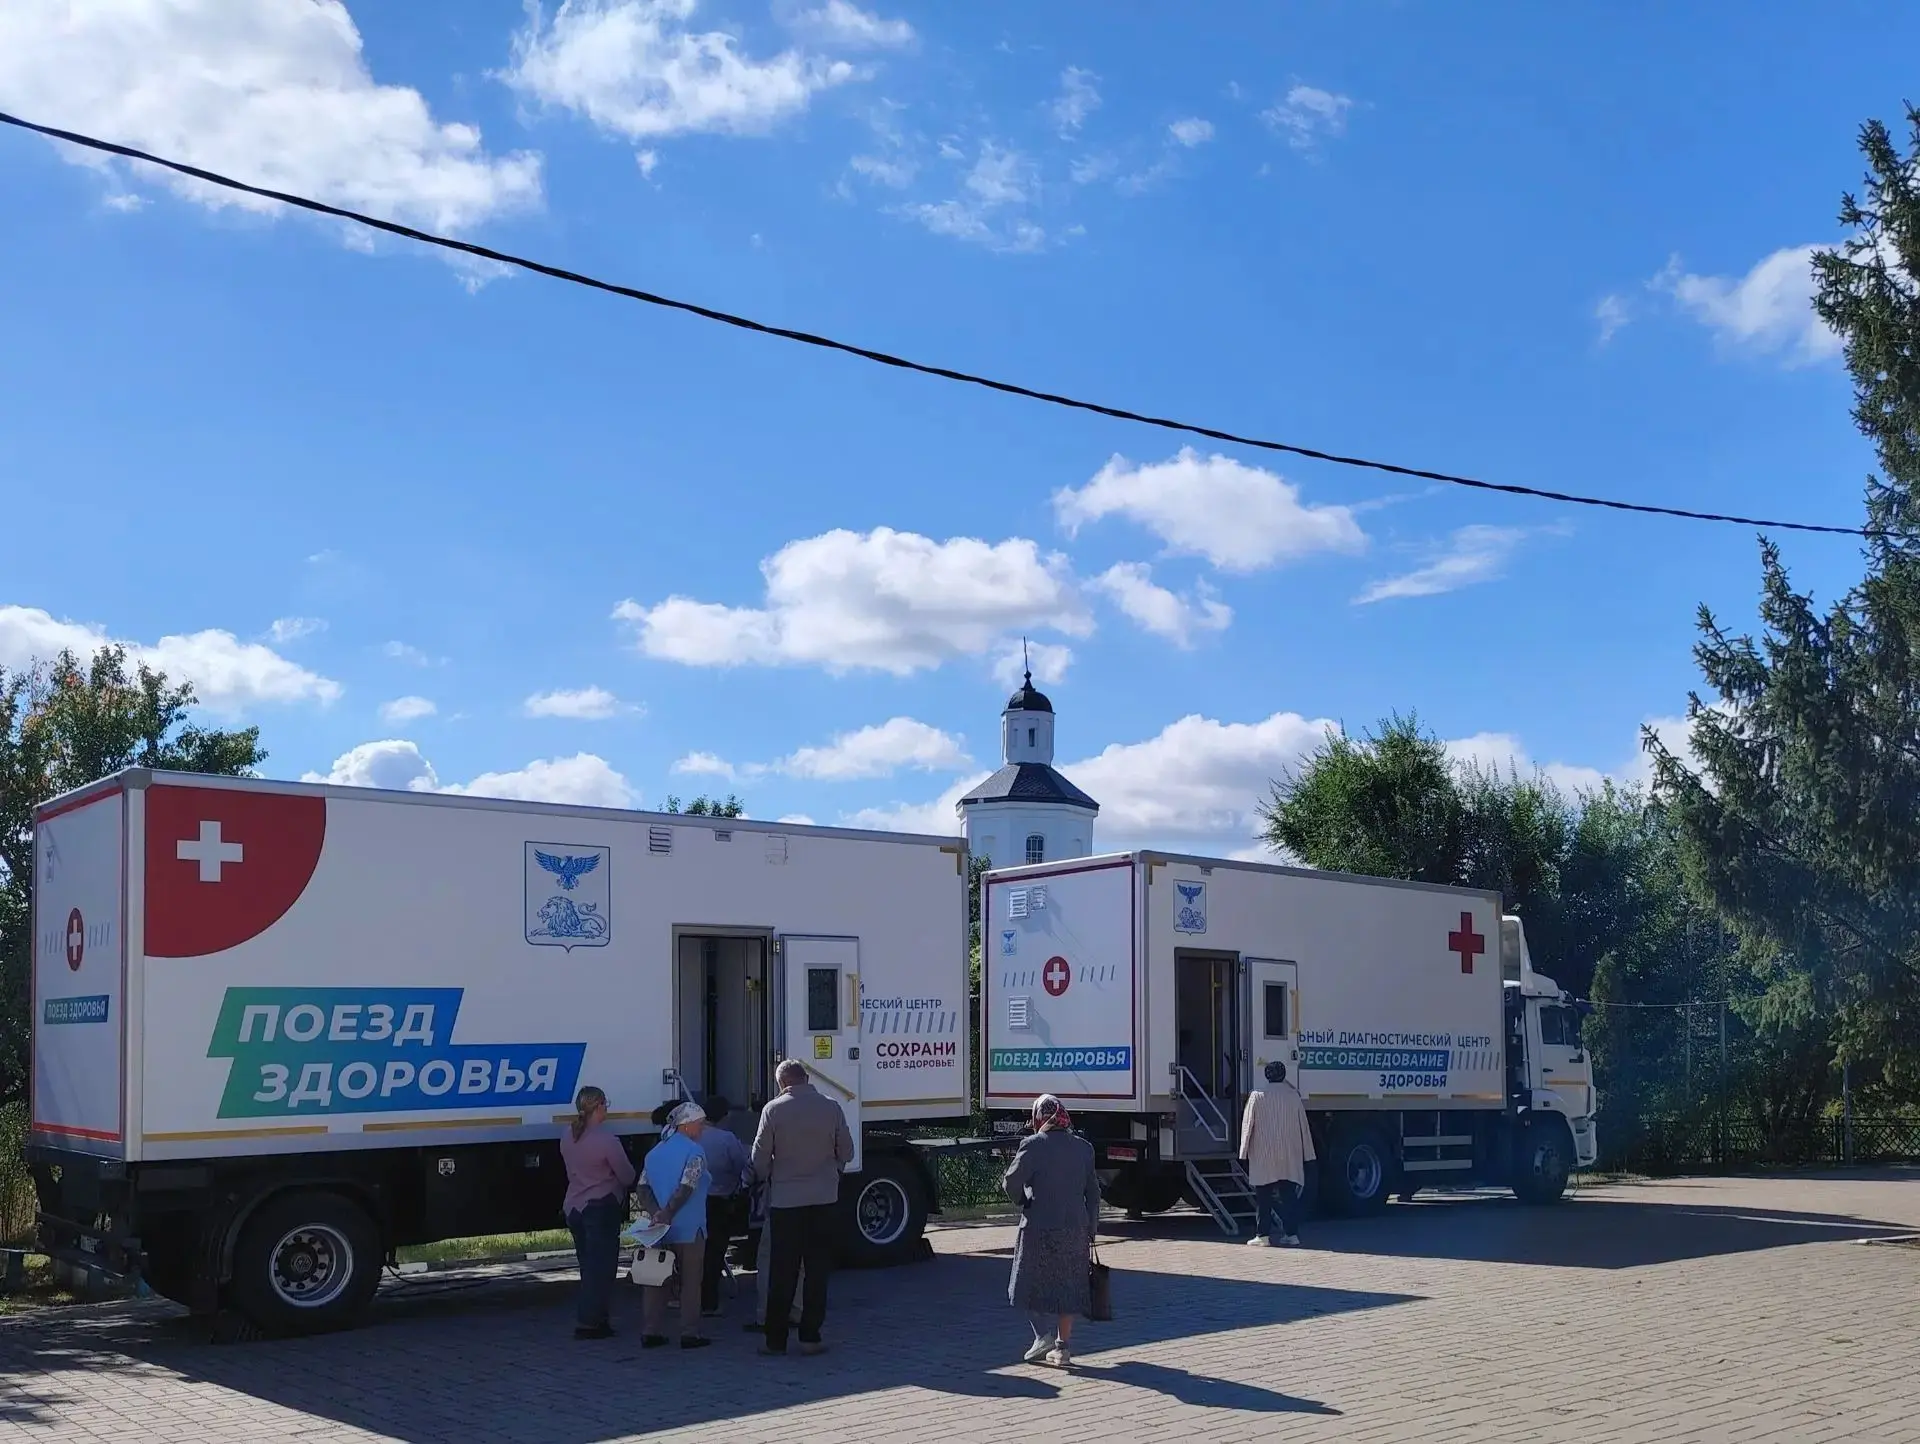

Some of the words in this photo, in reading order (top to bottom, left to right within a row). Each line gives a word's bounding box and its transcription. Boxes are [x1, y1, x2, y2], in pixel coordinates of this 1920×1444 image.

[47, 1003, 69, 1021] ПОЕЗД
[69, 1000, 106, 1020] ЗДОРОВЬЯ
[906, 999, 942, 1011] ЦЕНТР
[238, 1003, 435, 1047] ПОЕЗД
[1339, 1031, 1452, 1047] ДИАГНОСТИЧЕСКИЙ
[1458, 1035, 1491, 1049] ЦЕНТР
[876, 1042, 956, 1057] СОХРАНИ
[876, 1059, 901, 1070] СВОЁ
[904, 1059, 955, 1070] ЗДОРОВЬЕ!
[993, 1052, 1040, 1068] ПОЕЗД
[1043, 1050, 1127, 1068] ЗДОРОВЬЯ
[253, 1057, 559, 1108] ЗДОРОВЬЯ
[1379, 1074, 1448, 1089] ЗДОРОВЬЯ
